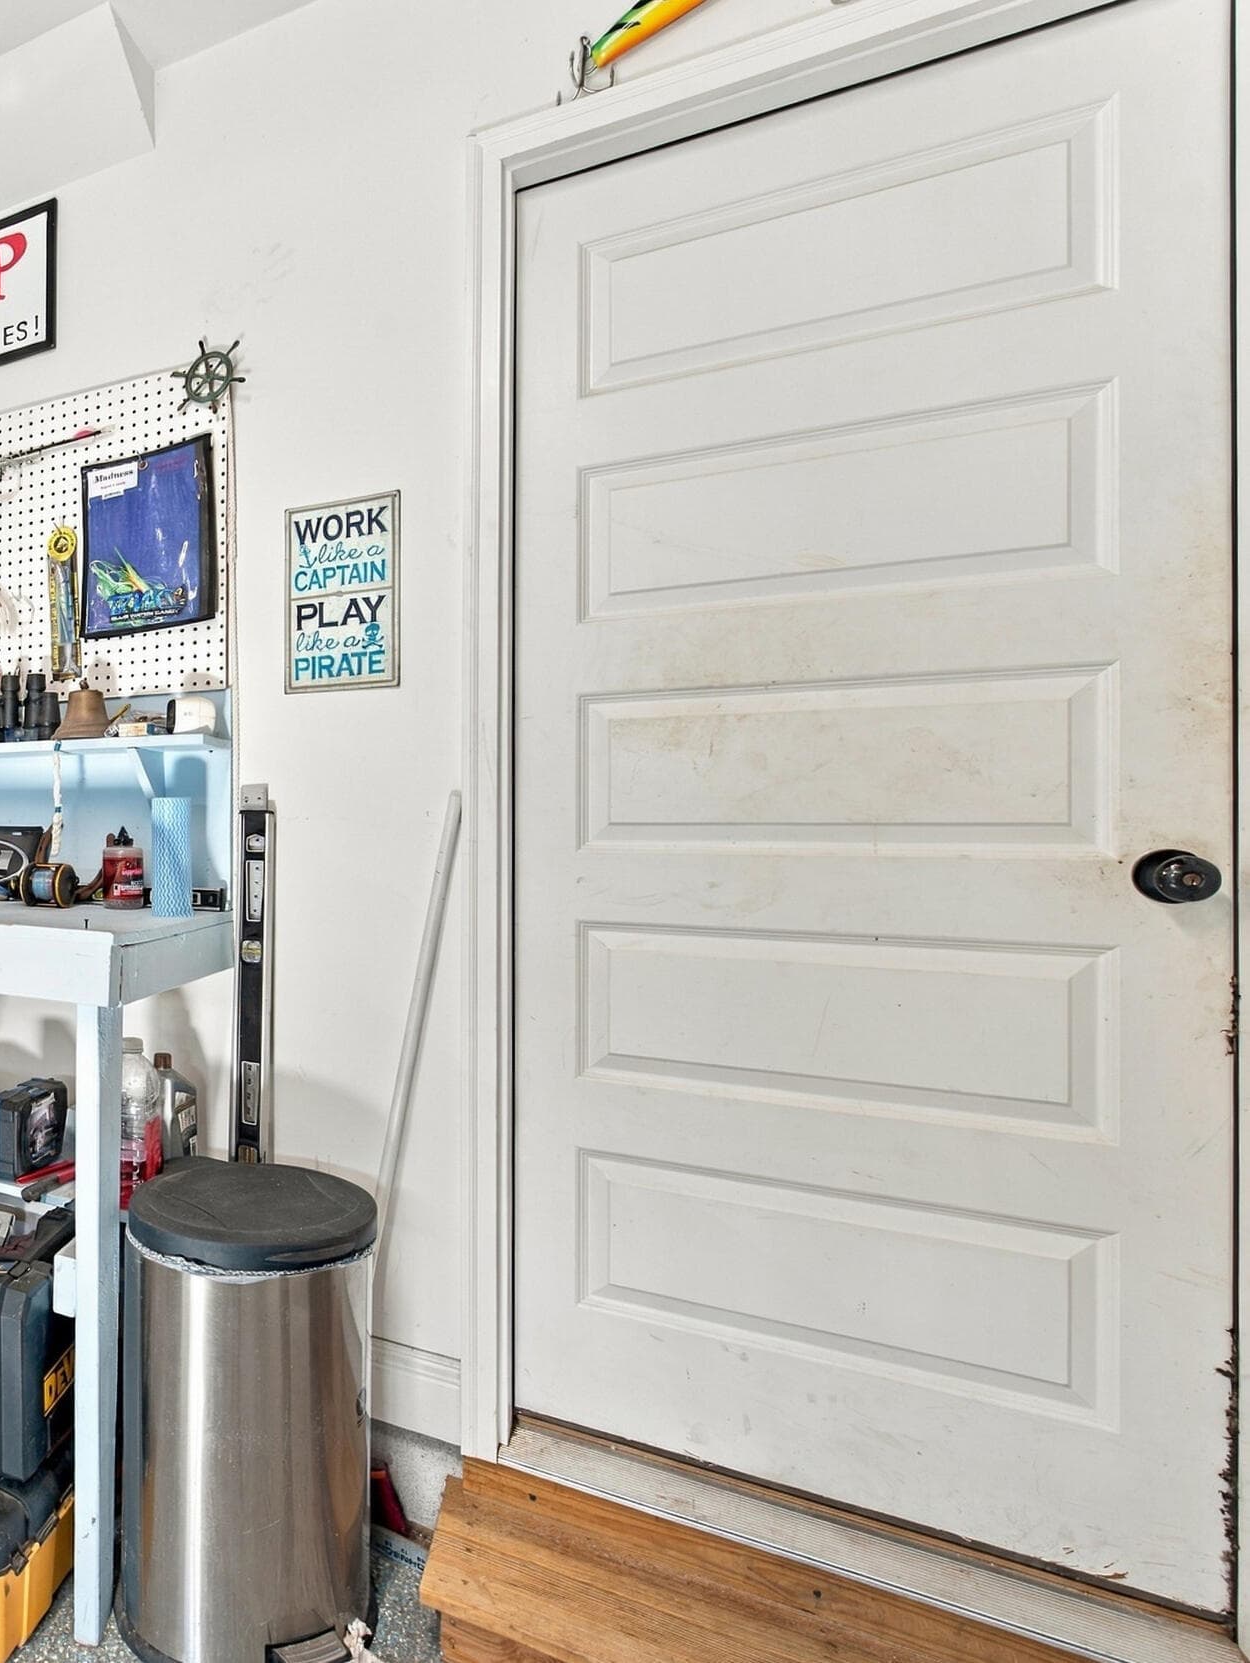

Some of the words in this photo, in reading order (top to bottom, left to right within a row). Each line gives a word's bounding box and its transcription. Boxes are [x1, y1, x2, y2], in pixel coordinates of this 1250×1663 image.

[294, 505, 389, 545] WORK
[318, 541, 364, 564] like
[367, 545, 385, 557] a
[294, 559, 386, 592] CAPTAIN
[296, 594, 387, 631] PLAY
[295, 630, 340, 652] like
[343, 635, 361, 648] a
[294, 649, 385, 681] PIRATE
